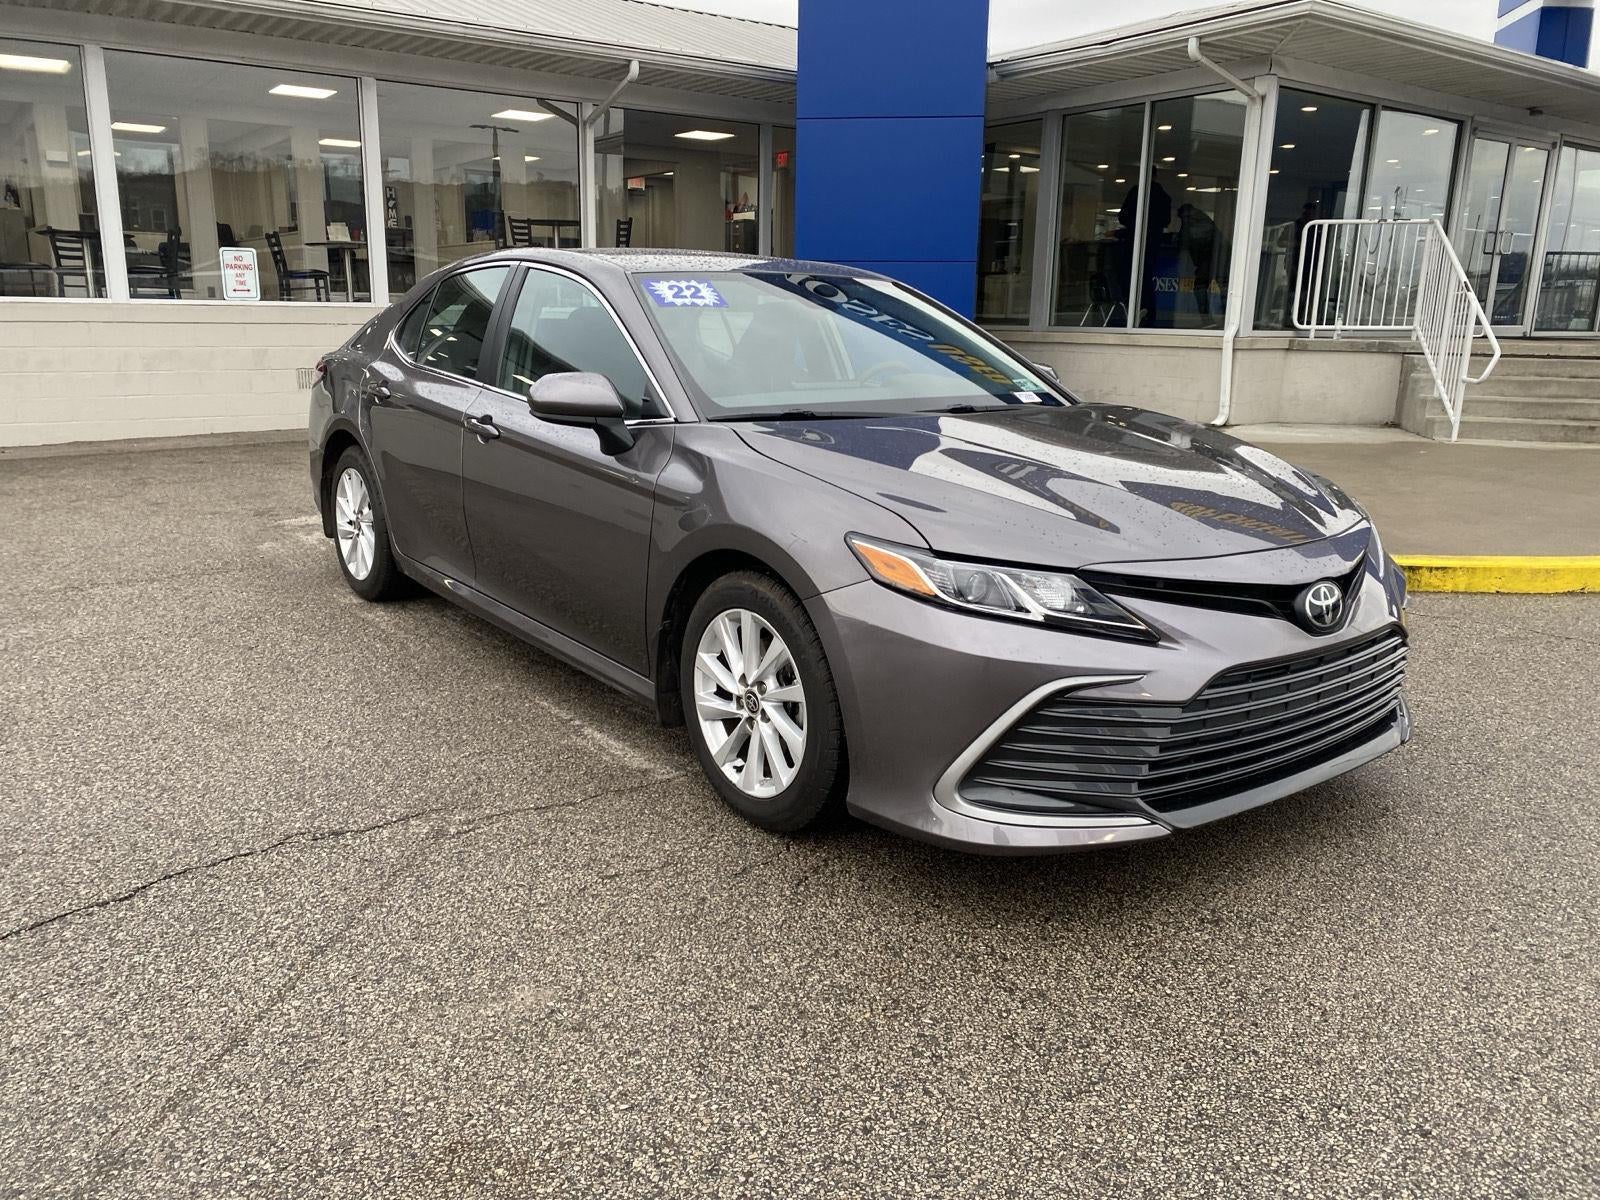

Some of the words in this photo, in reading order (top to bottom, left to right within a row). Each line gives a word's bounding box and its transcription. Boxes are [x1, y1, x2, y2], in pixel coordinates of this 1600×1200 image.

[225, 263, 254, 271] PARKING
[235, 279, 247, 287] TIME
[667, 284, 706, 300] 22
